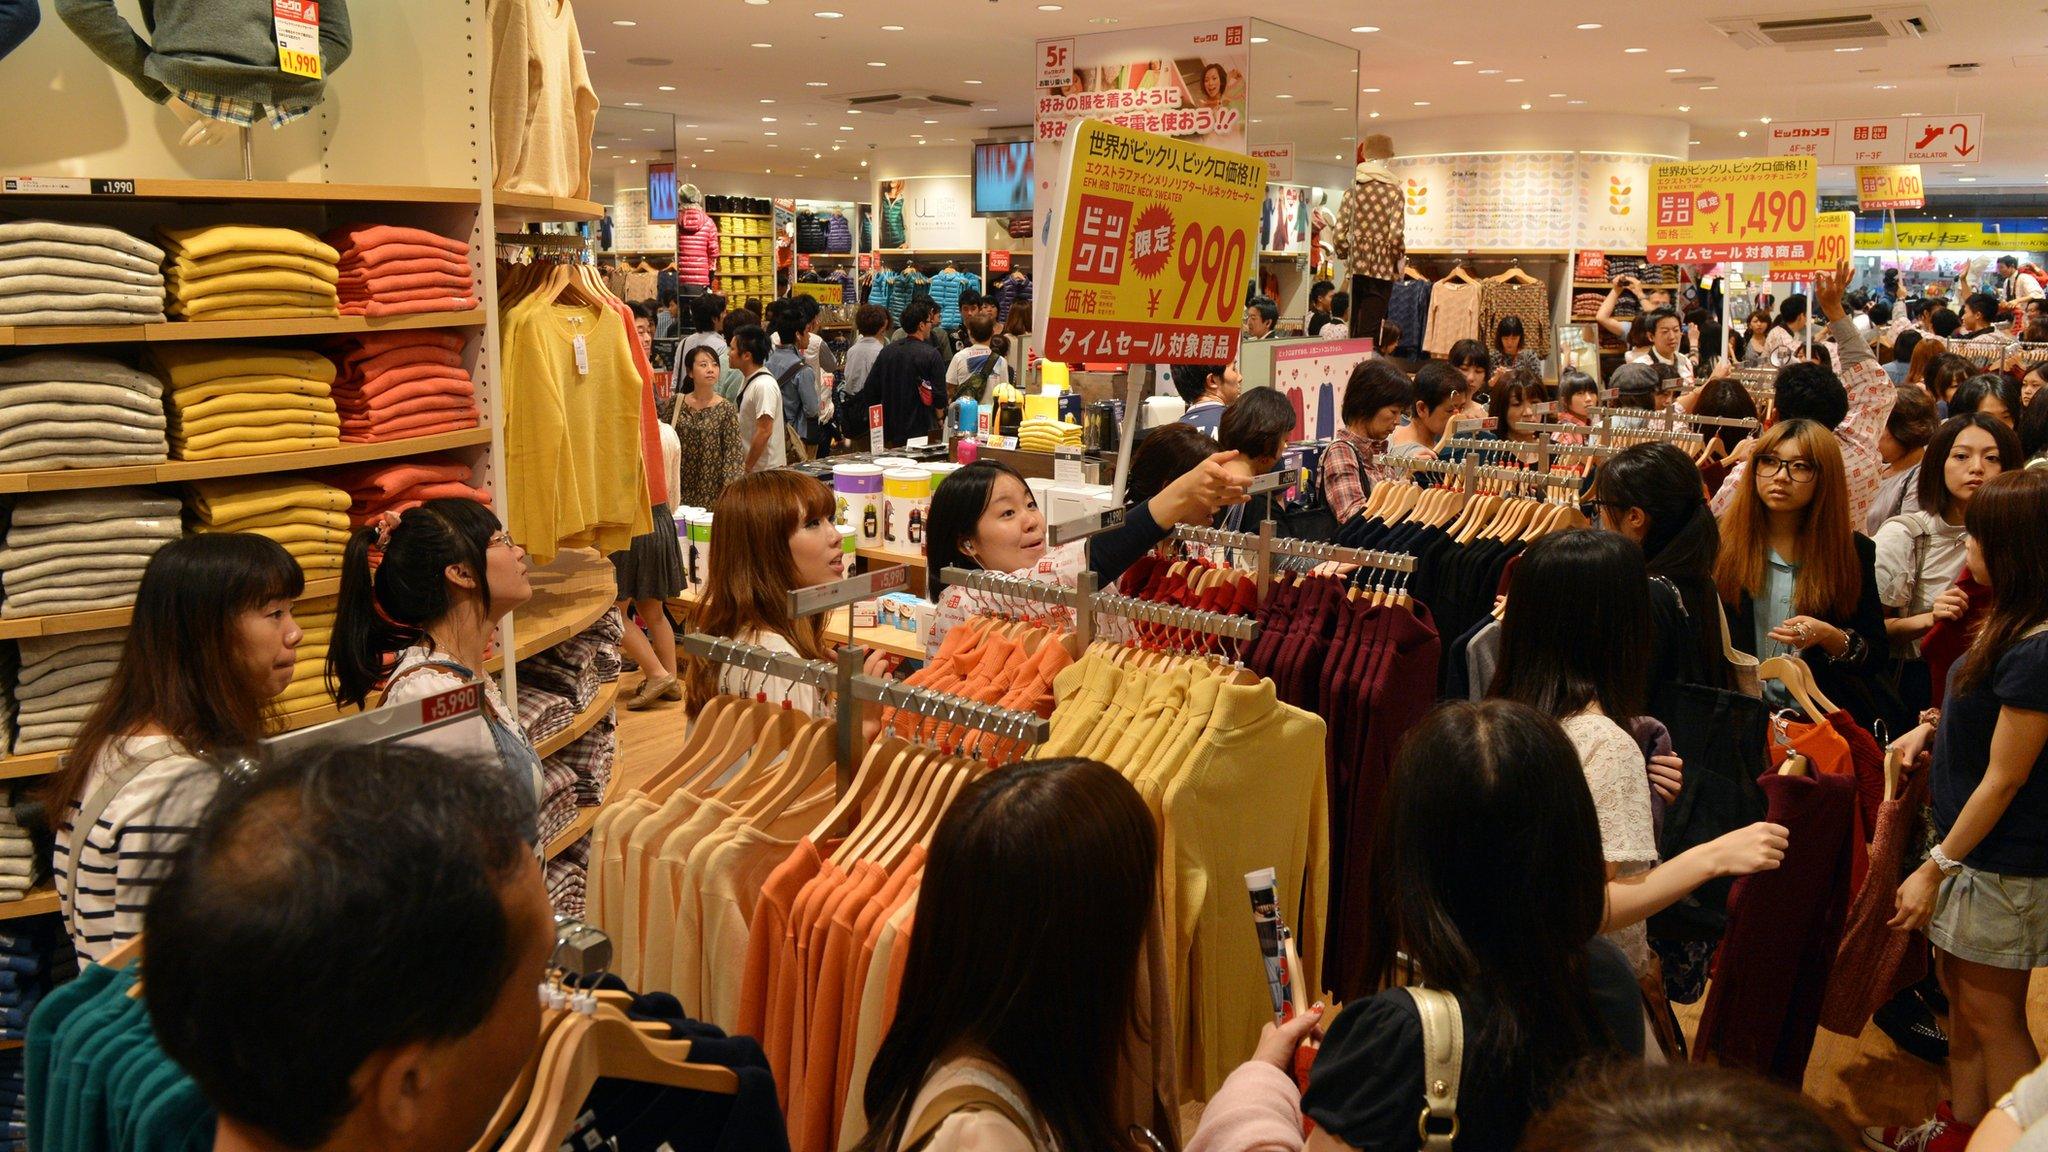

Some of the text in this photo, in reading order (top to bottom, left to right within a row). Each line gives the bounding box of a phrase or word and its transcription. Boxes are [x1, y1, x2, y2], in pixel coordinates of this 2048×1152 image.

[283, 51, 317, 74] ¥1,990
[1045, 45, 1067, 67] 5F
[1039, 89, 1178, 113] 好みの服を着るように
[1773, 127, 1831, 138] ビックカメラ
[1789, 143, 1817, 152] 4F-8F
[1855, 151, 1882, 160] 1F-3F
[1908, 151, 1948, 159] ESCALATOR
[1088, 130, 1261, 189] 世界がビックリ、ビックロ価格!!
[1658, 159, 1808, 177] 世界がビックリ、ビックロ価格!!
[103, 181, 133, 194] ¥1,990
[1085, 162, 1255, 202] エクストラファインメリノリブタートルネックセーター
[1657, 171, 1808, 186] エクストラファインメリノVネックチュニック
[1082, 178, 1183, 203] EFM RIB TURTLE NECK SWEATER
[1697, 196, 1719, 209] 限定
[1709, 189, 1806, 240] ¥1,490
[1134, 225, 1171, 260] 限定
[1656, 229, 1679, 240] 価格
[1896, 232, 1969, 246] マツモトキヨシ
[1655, 245, 1805, 261] タイムセール対象商品
[1064, 288, 1098, 315] 価格
[1058, 327, 1230, 359] タイムセール対象商品
[431, 688, 476, 719] ¥5,990
